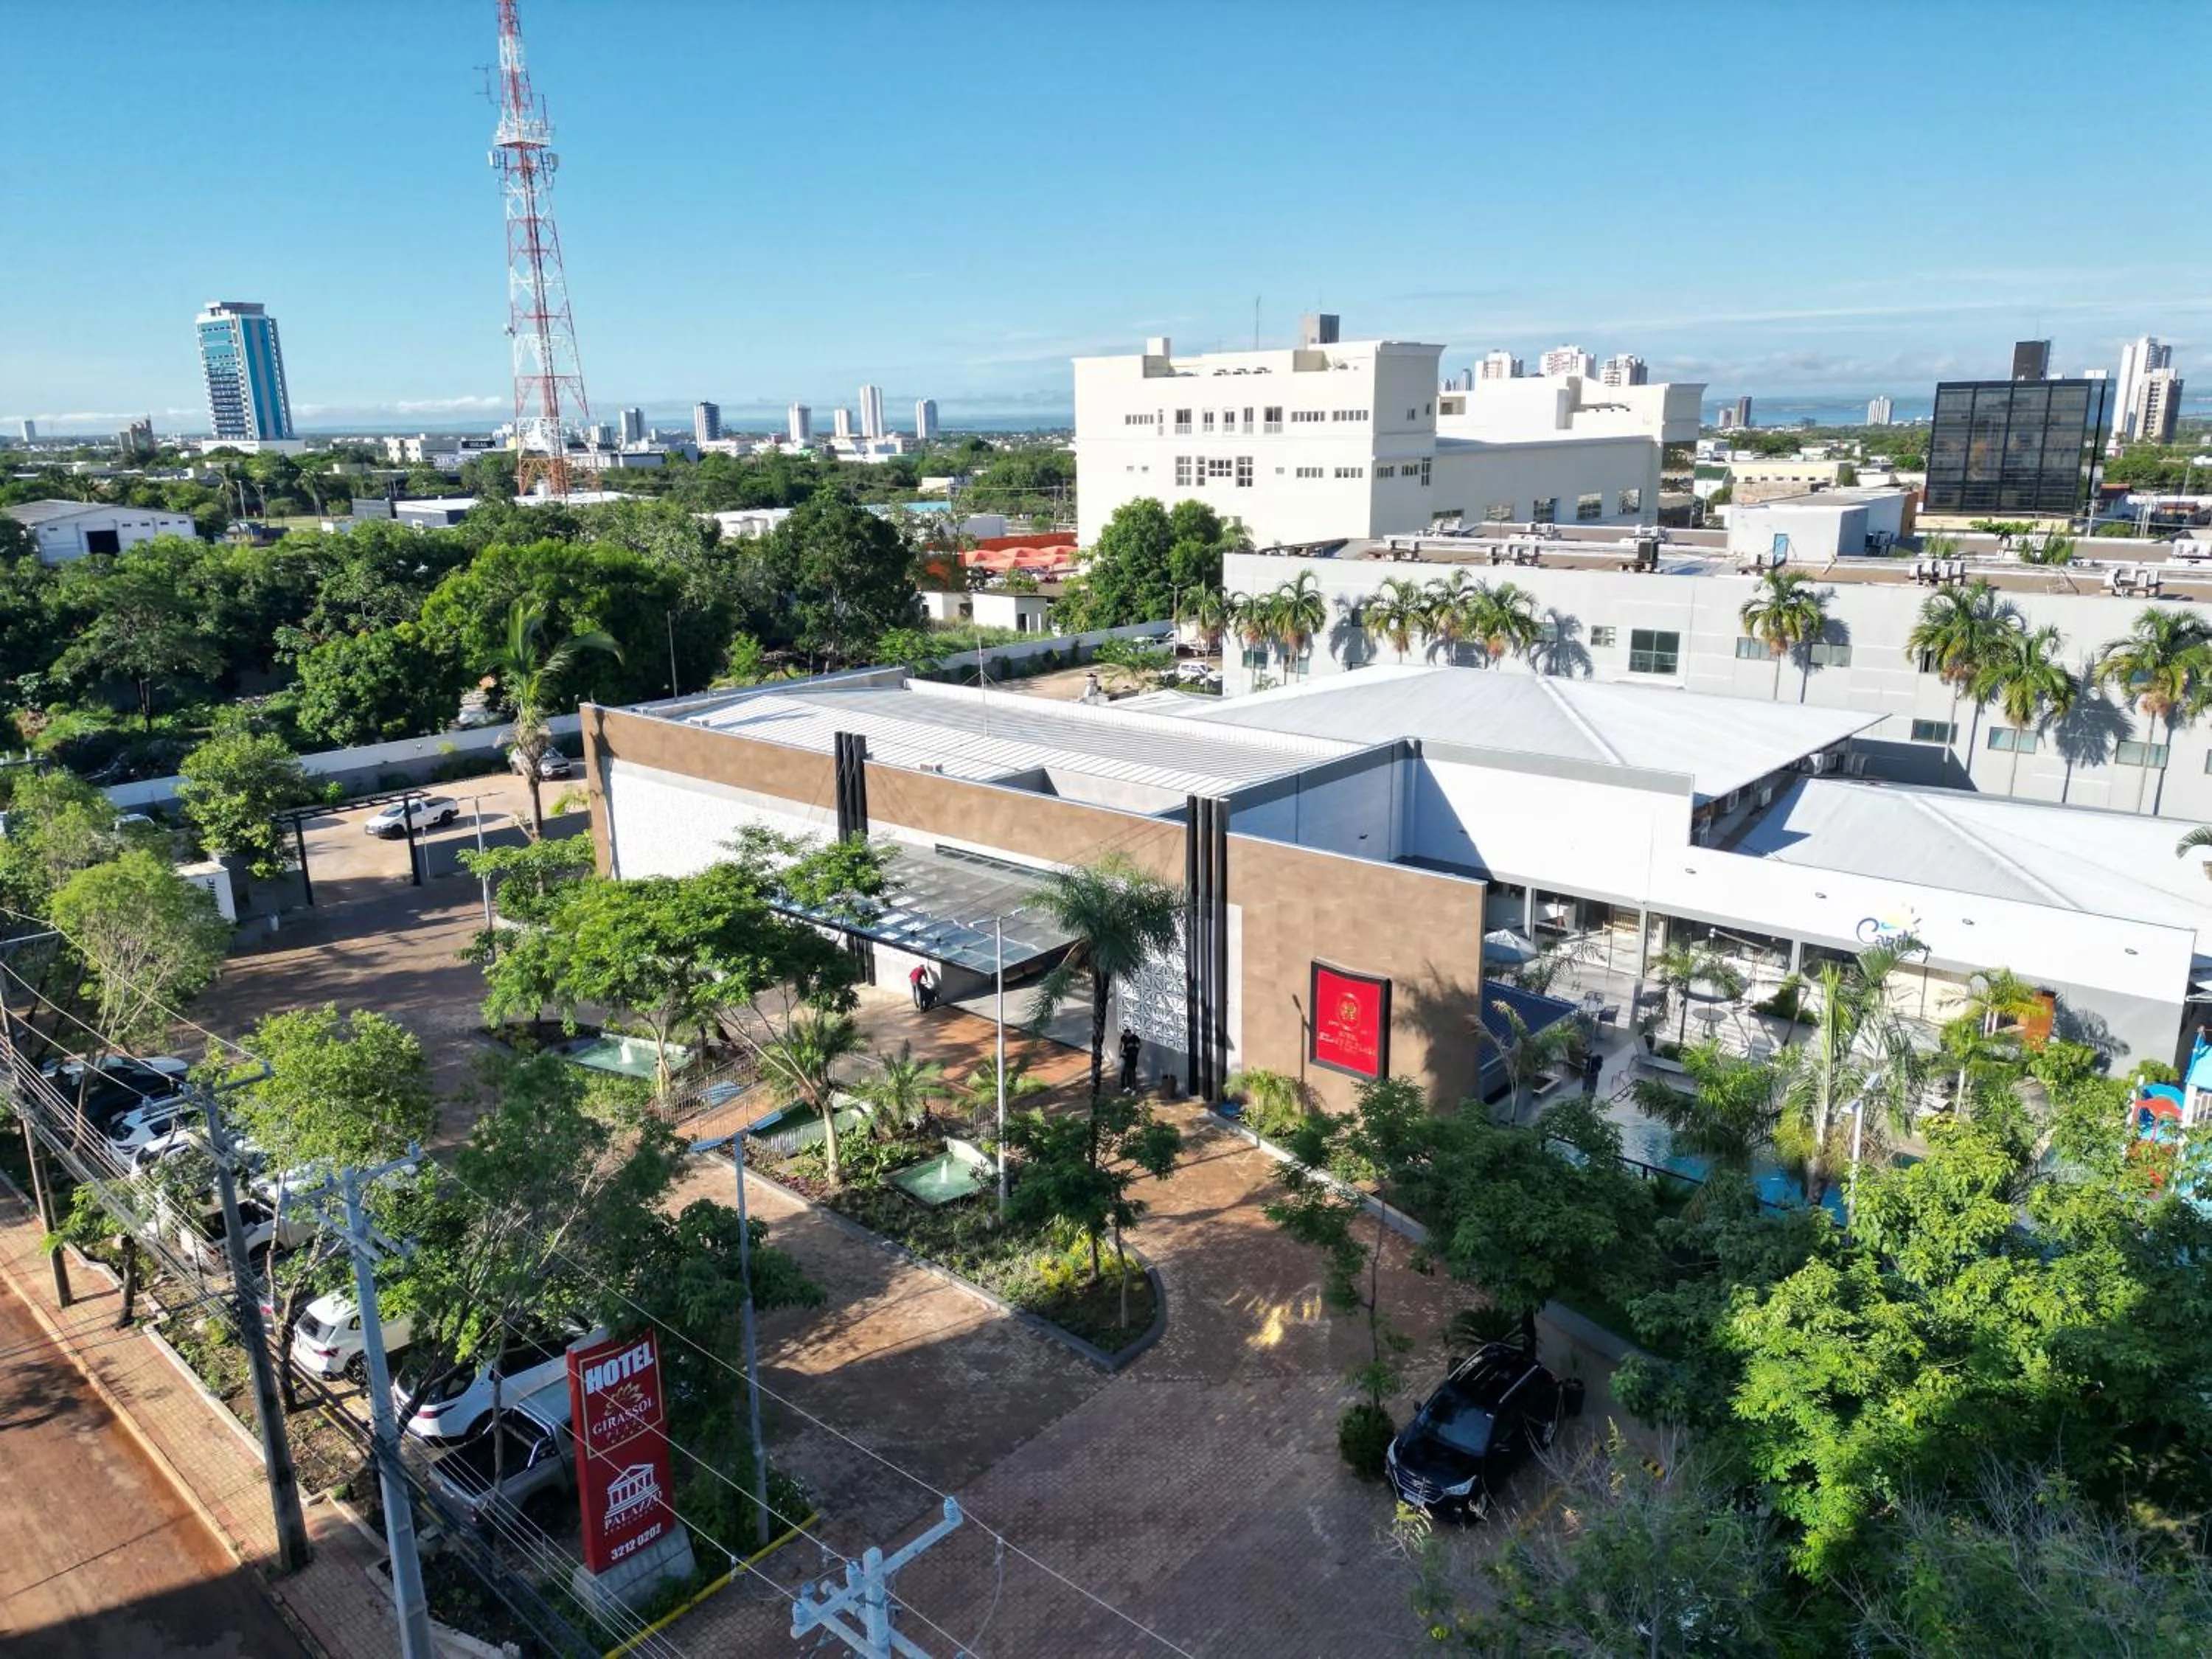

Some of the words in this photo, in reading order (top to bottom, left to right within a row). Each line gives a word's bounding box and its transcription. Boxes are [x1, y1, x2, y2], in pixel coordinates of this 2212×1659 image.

[585, 1341, 654, 1396] HOTEL
[592, 1397, 653, 1435] GIRASSOL
[604, 1490, 663, 1531] PALAZZO
